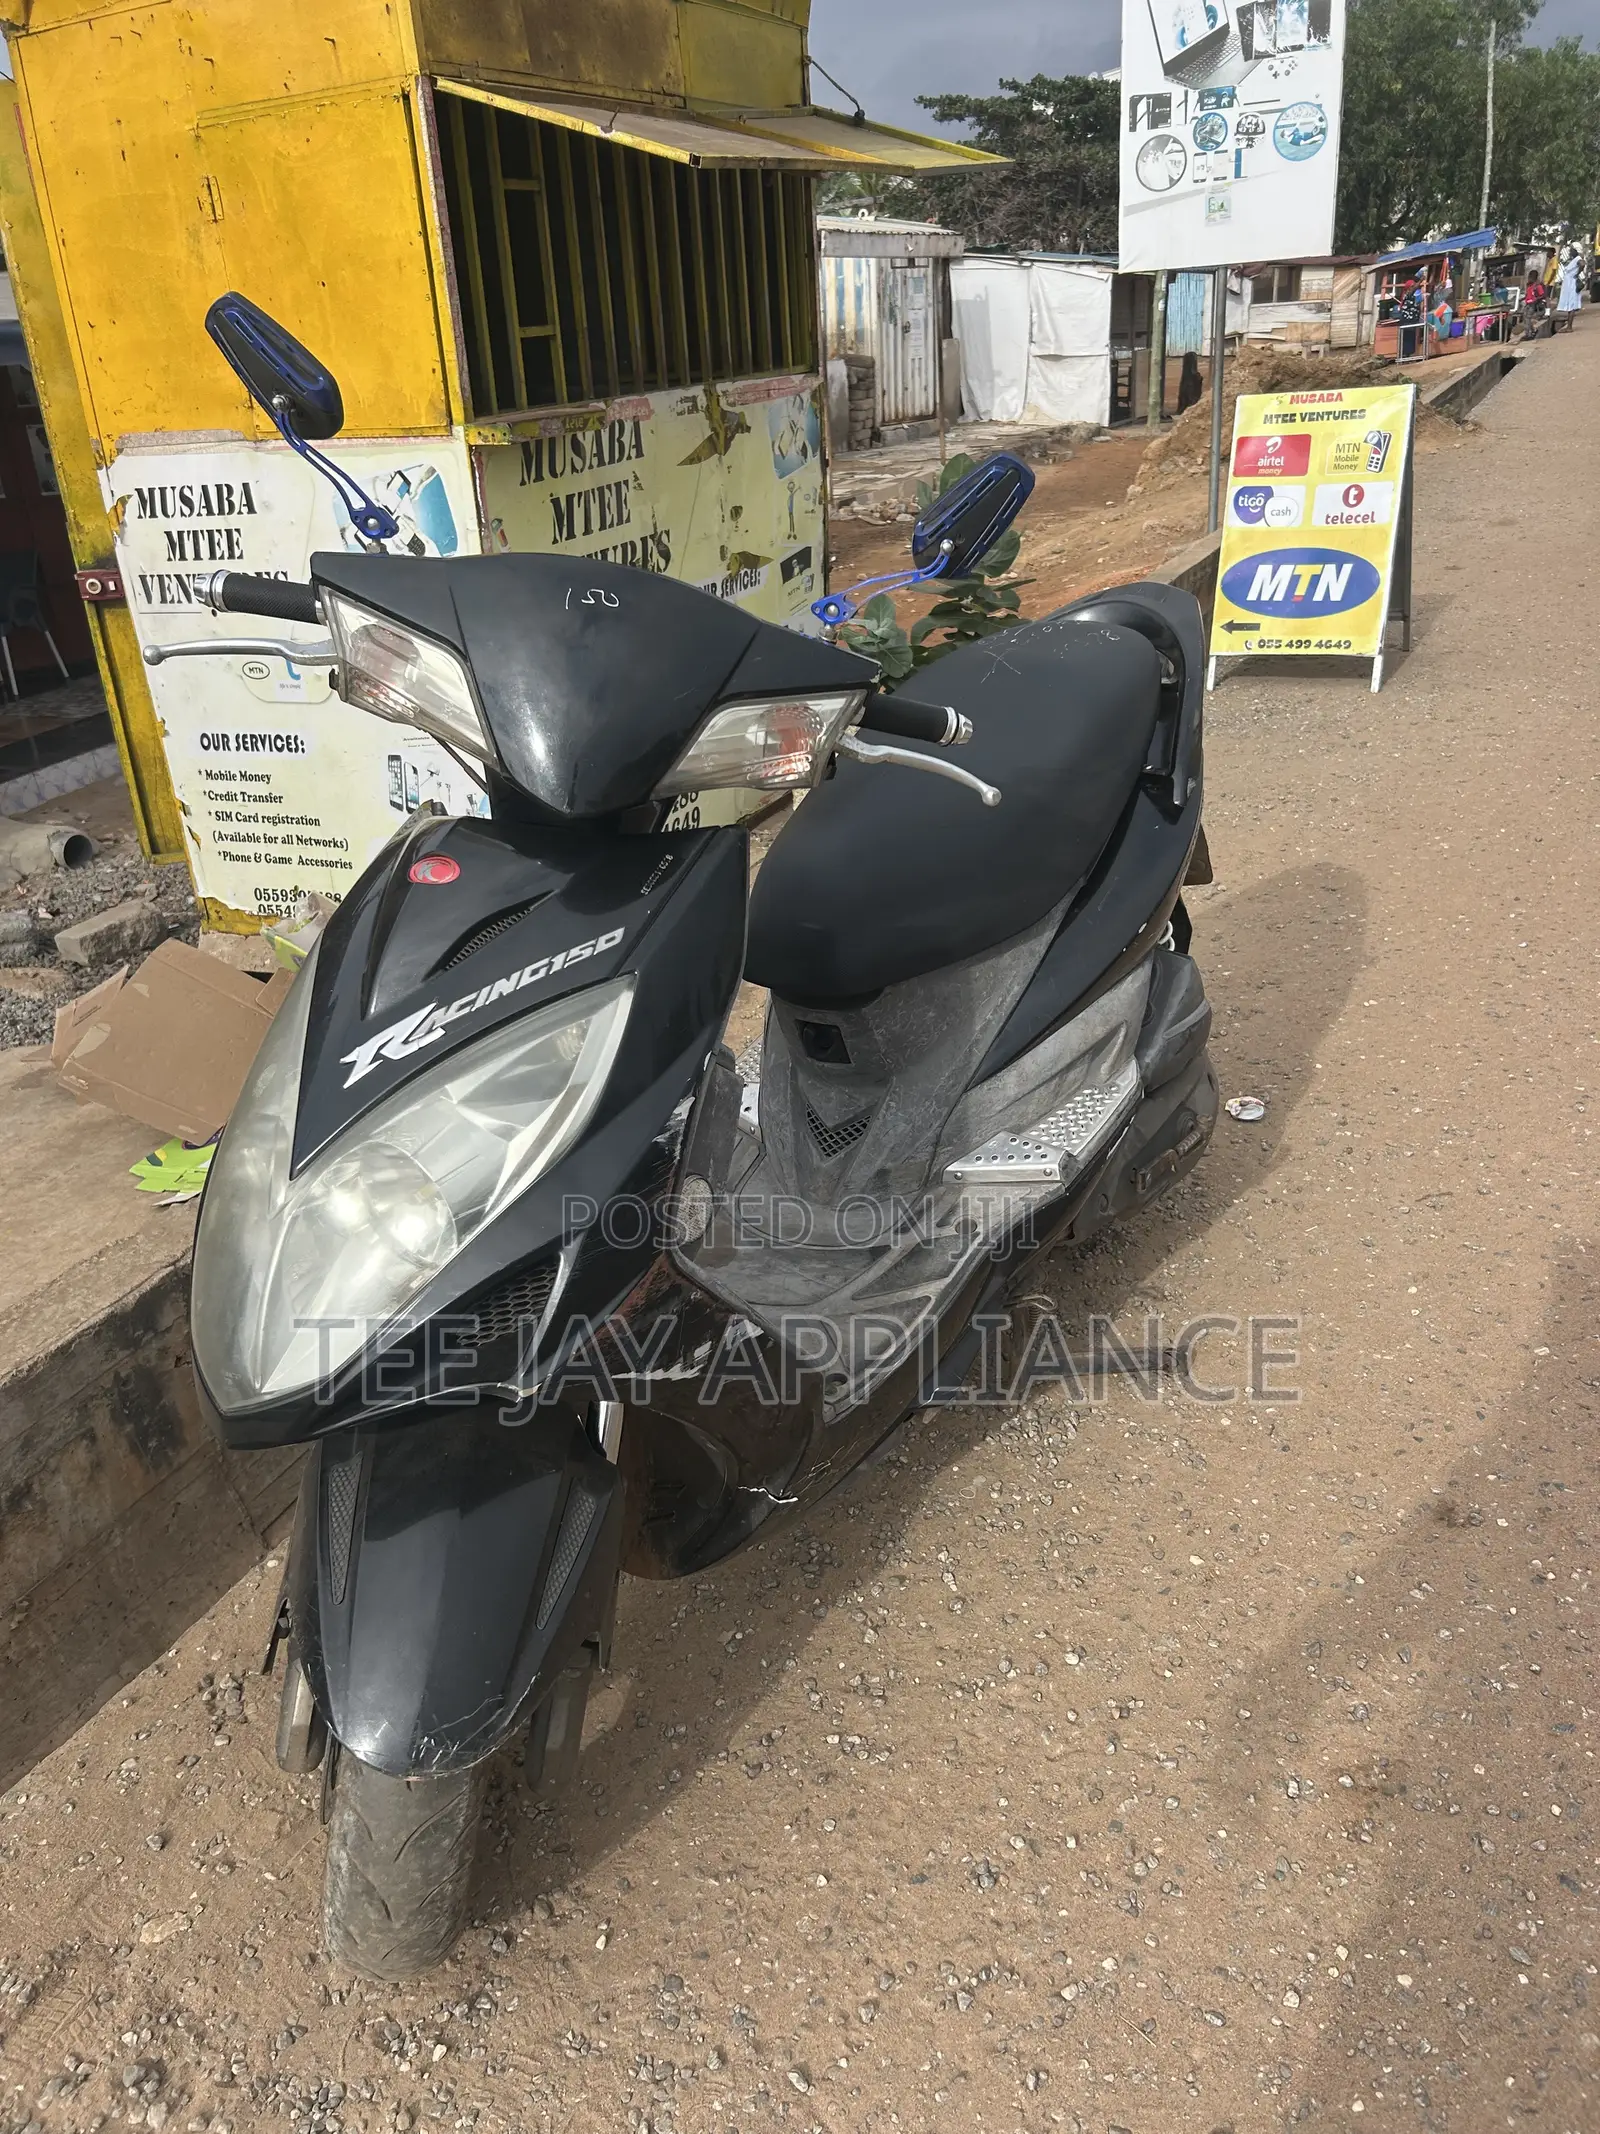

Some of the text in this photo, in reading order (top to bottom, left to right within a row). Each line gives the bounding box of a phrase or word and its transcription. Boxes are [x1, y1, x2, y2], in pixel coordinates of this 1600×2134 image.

[1289, 392, 1343, 404] MUSABA
[1300, 409, 1366, 423] VENTURES
[519, 415, 644, 486] MUSABA
[1335, 442, 1360, 454] MTN
[1257, 456, 1284, 467] airtel
[1334, 454, 1359, 463] Mobile
[1258, 468, 1282, 476] money
[1333, 463, 1358, 472] Money
[134, 482, 257, 519] MUSABA
[1238, 493, 1265, 512] tigo
[550, 479, 631, 546] MTEE
[1270, 506, 1292, 517] cash
[1325, 511, 1375, 525] telecel
[164, 528, 244, 562] MTEE
[1246, 563, 1353, 603] MTN
[1257, 639, 1352, 650] 055 499 4649
[248, 666, 264, 675] MTN
[200, 732, 305, 754] OUR SERVICES:
[205, 769, 272, 785] Mobile Money
[240, 791, 284, 804] Transfer
[215, 810, 321, 827] SIM Card registration
[213, 830, 349, 852] (Available for all Networks)
[253, 852, 262, 863] &
[264, 853, 293, 865] Game
[297, 854, 353, 870] Accessories
